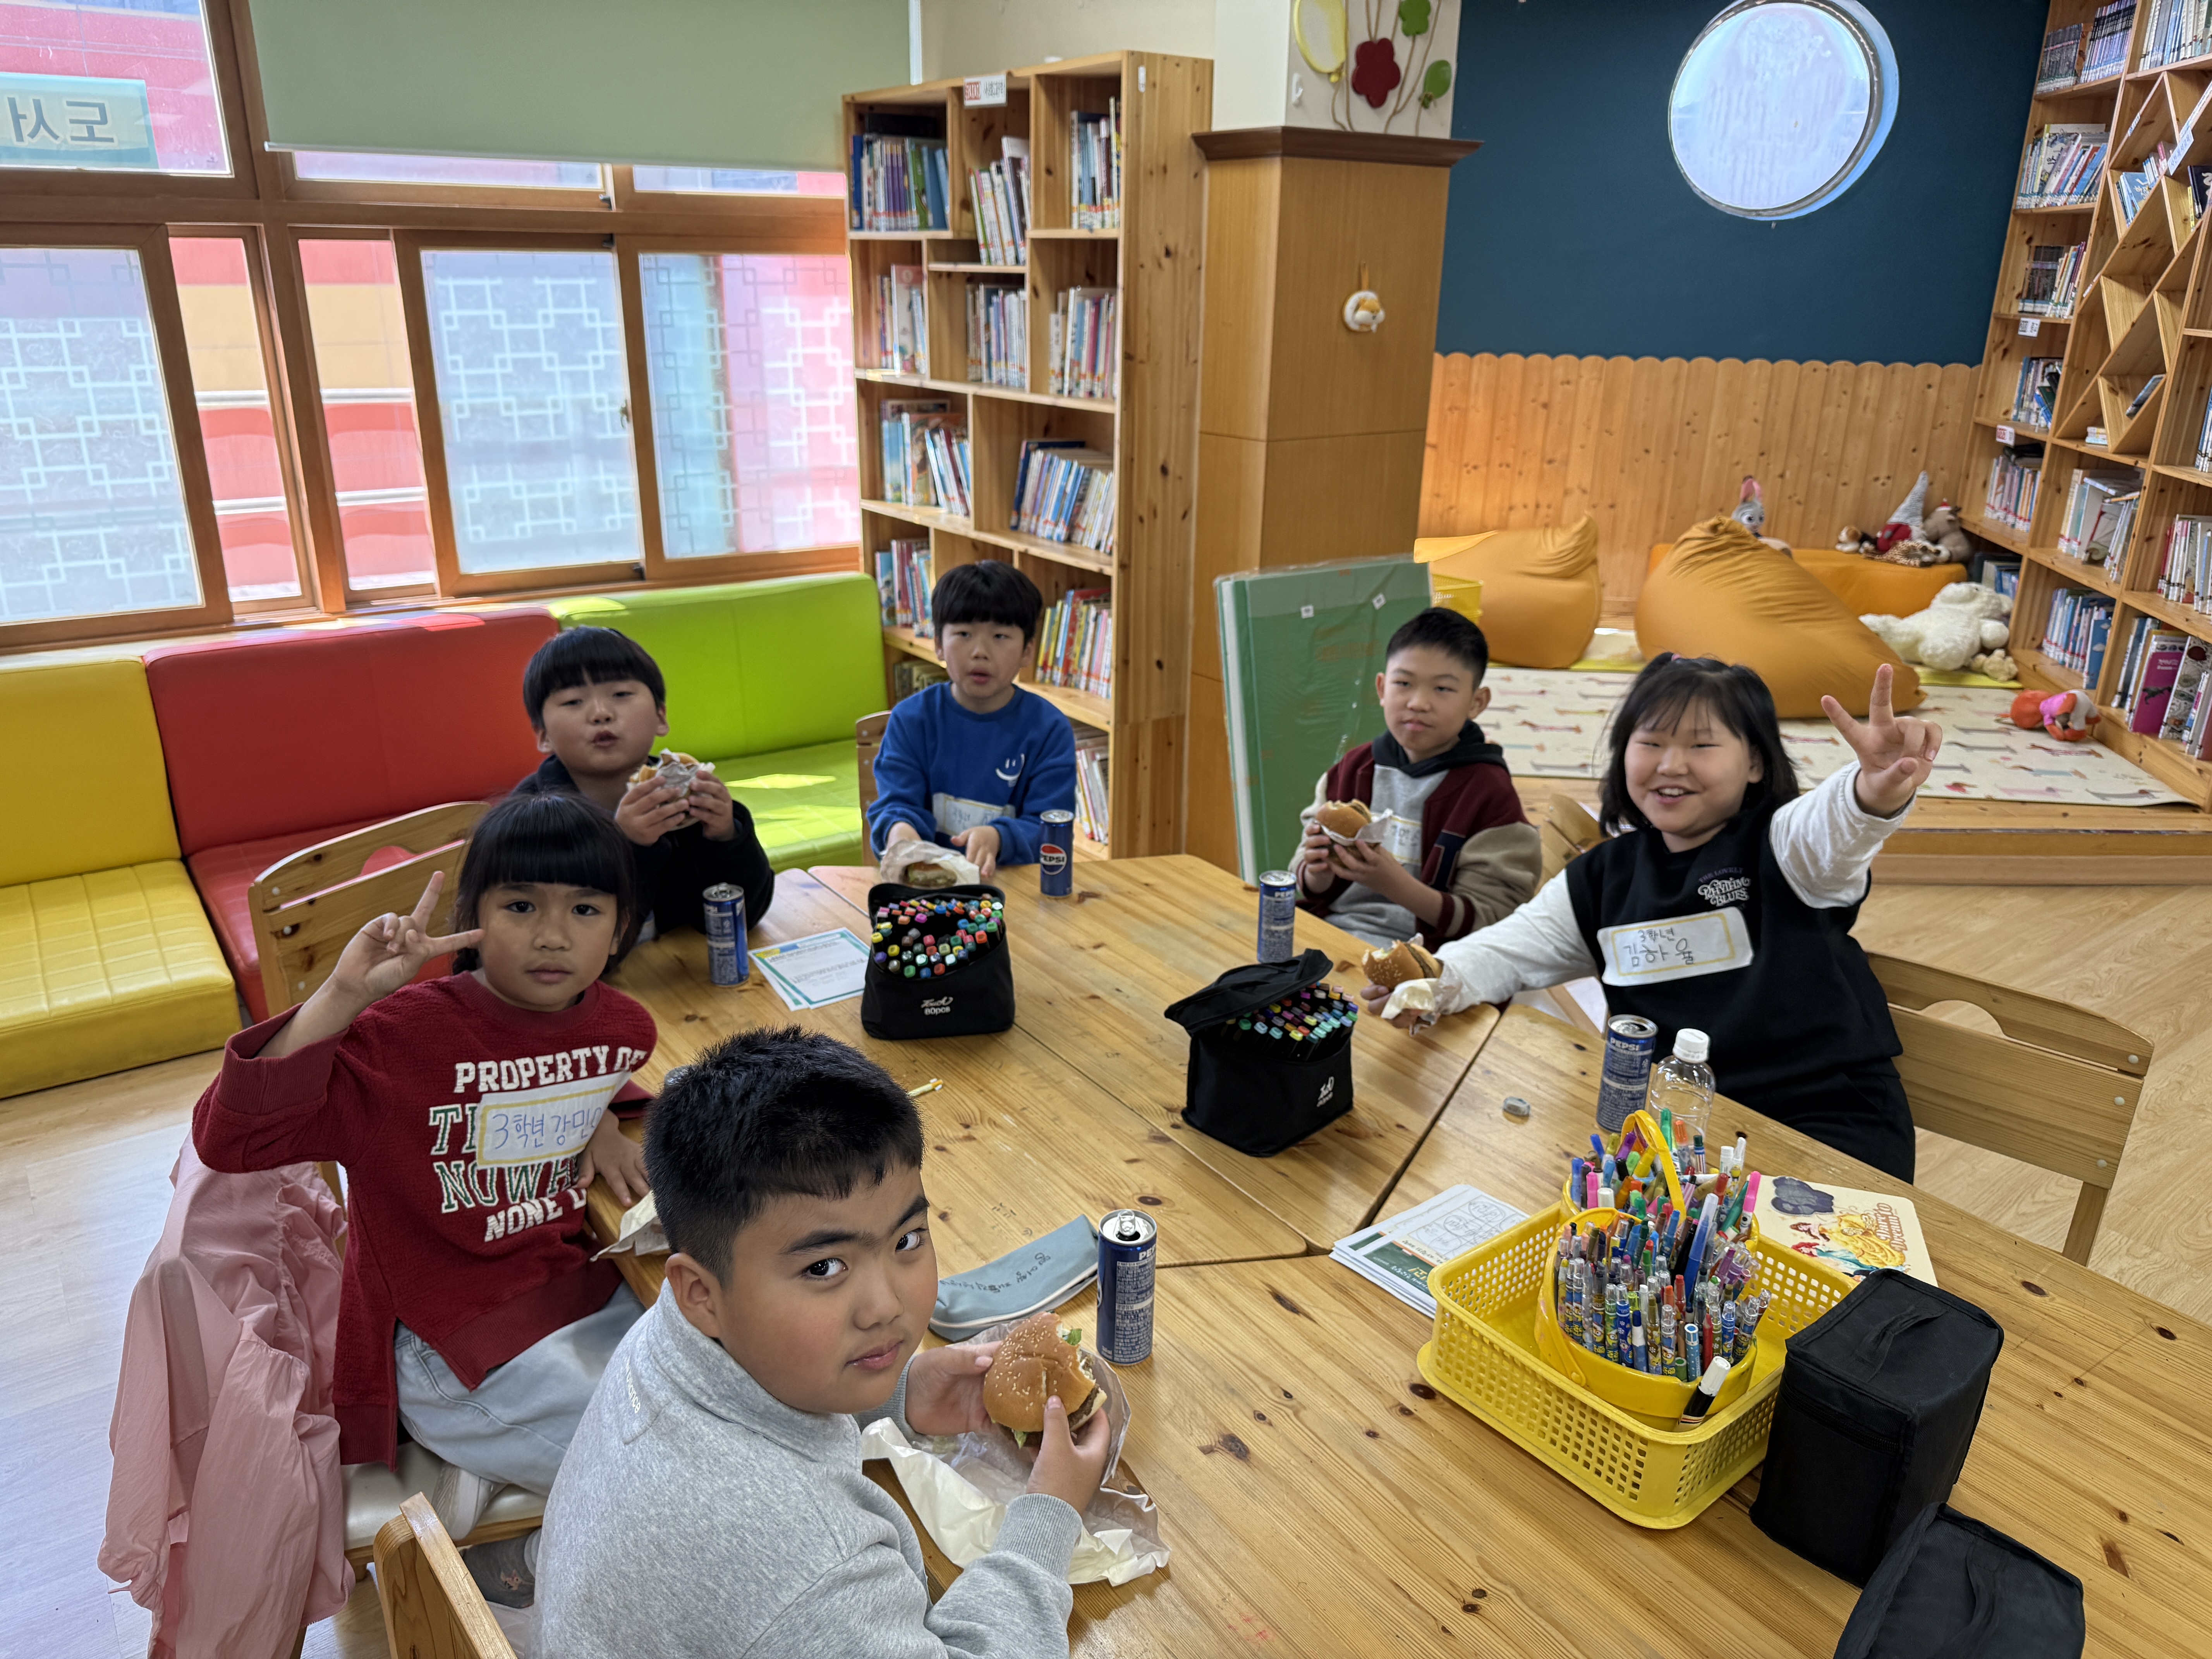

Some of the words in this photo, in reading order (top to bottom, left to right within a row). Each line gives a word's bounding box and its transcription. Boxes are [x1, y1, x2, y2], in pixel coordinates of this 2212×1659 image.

[1710, 888, 1749, 907] BLUES
[1638, 927, 1675, 943] 3학년
[1610, 1037, 1640, 1051] PEPSI
[454, 1045, 610, 1094] PROPERTY
[492, 1113, 544, 1149] 3학년
[484, 1196, 563, 1242] NONE
[1873, 1202, 1893, 1216] to
[1874, 1213, 1892, 1240] Dare
[1888, 1215, 1908, 1252] Dream
